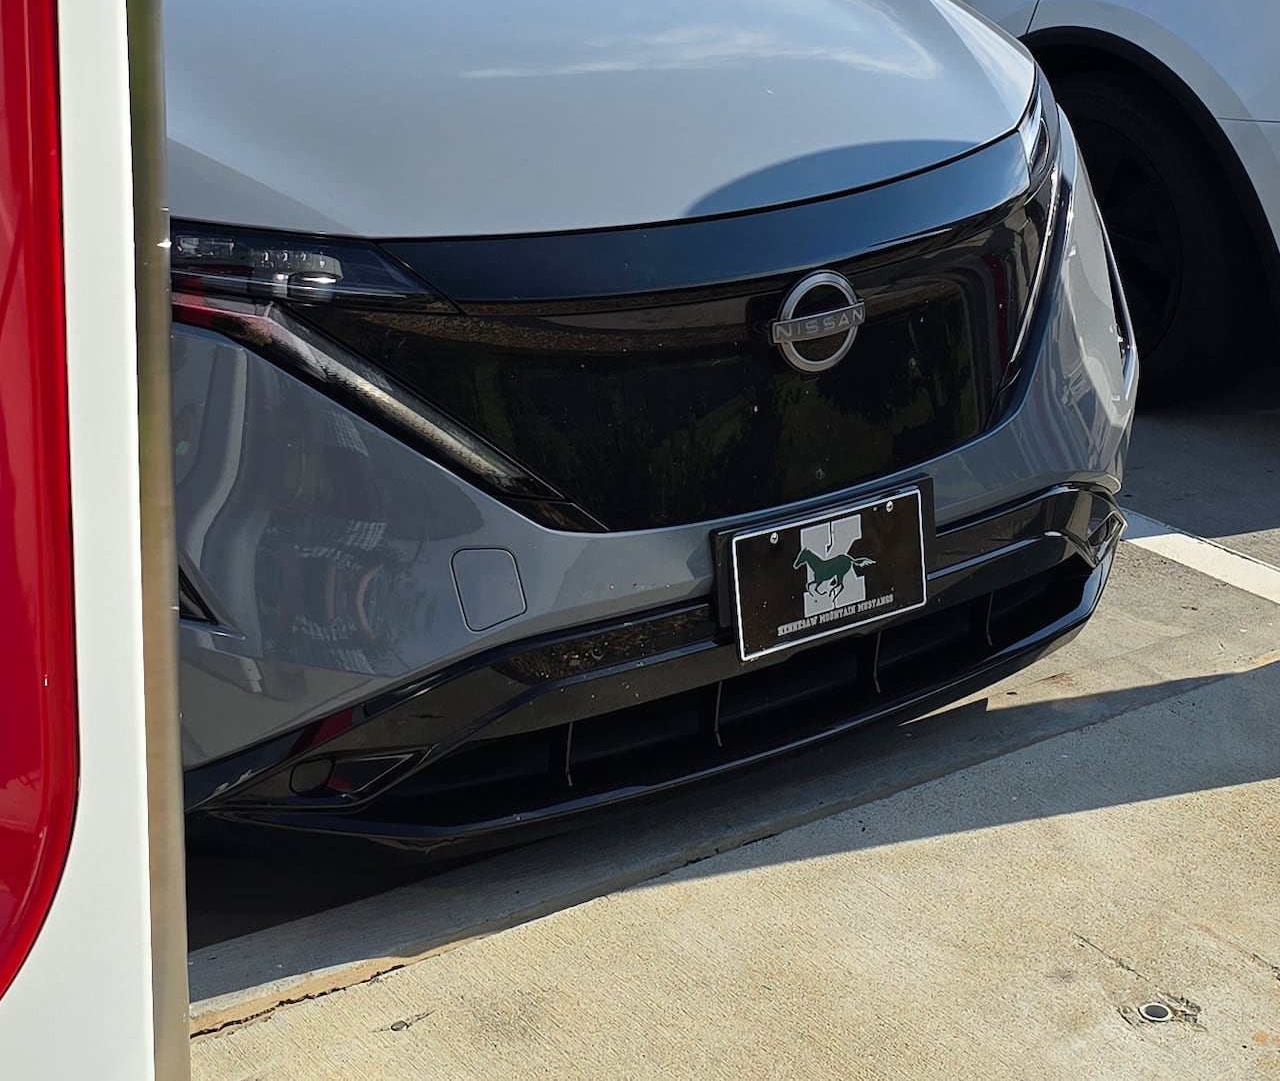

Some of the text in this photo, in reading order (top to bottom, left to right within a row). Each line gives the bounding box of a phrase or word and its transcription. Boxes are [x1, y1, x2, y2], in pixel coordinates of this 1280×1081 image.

[776, 307, 864, 339] NISSAN
[819, 606, 856, 624] MOUNTAIN
[857, 594, 895, 613] MUSTANGS
